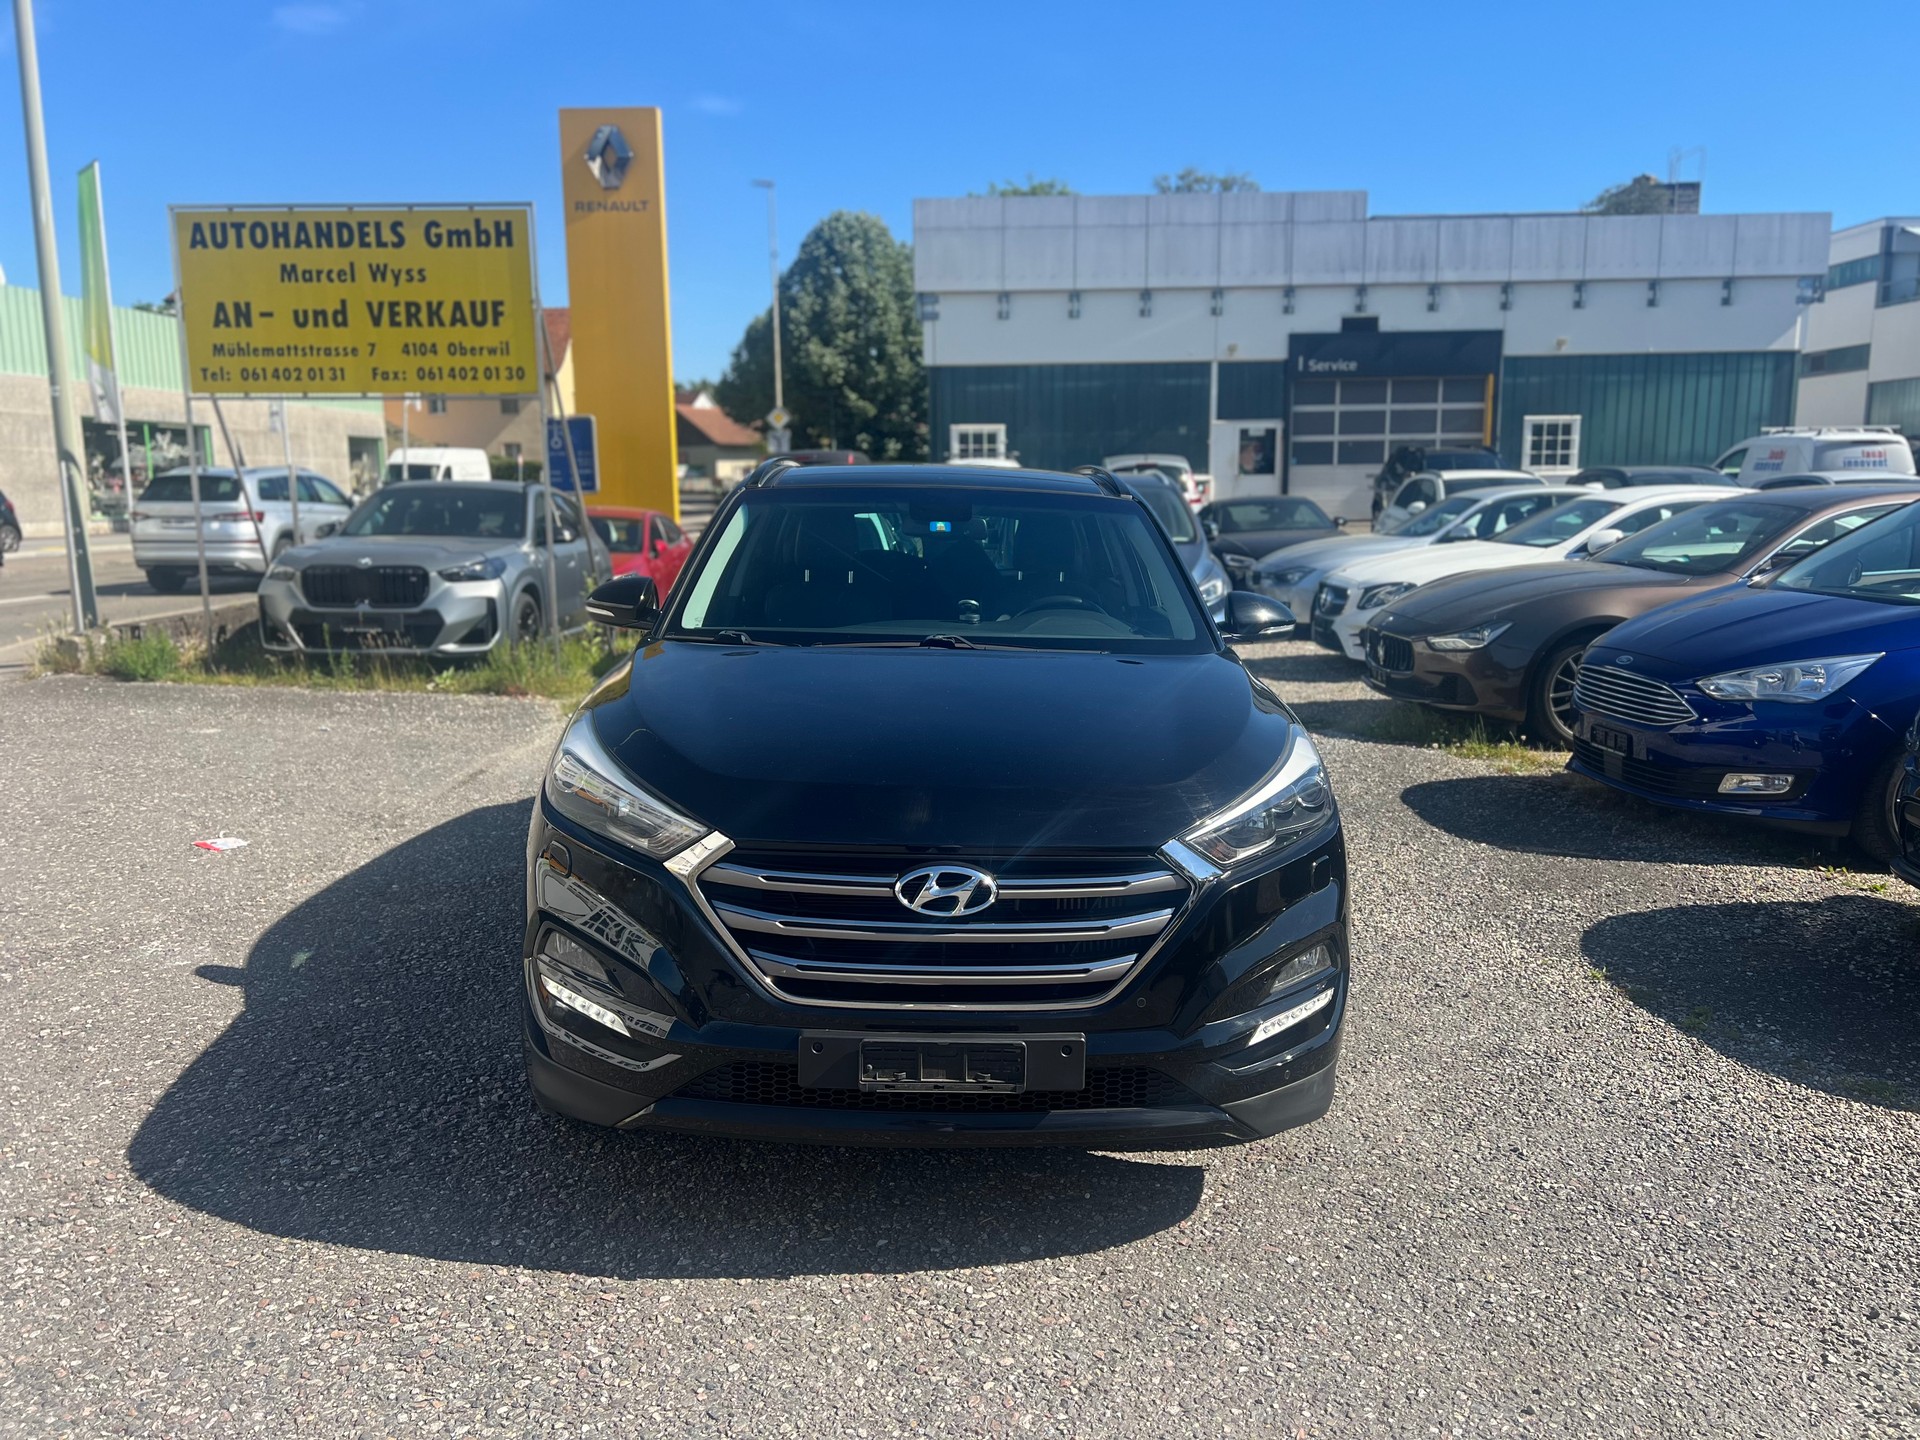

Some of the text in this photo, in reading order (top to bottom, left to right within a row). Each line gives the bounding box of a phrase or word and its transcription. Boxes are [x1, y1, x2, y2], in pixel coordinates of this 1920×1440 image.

[574, 199, 649, 212] RENAULT
[189, 218, 514, 250] AUTOHANDELS GmbH
[279, 261, 427, 287] Marcel Wyss
[292, 298, 348, 328] und
[365, 300, 505, 328] VERKAUF
[212, 340, 510, 357] Mühlemattstrasse 7 4104 Oberwil
[1307, 357, 1358, 373] Service
[200, 367, 231, 382] Tel:
[371, 366, 407, 381] Fax:
